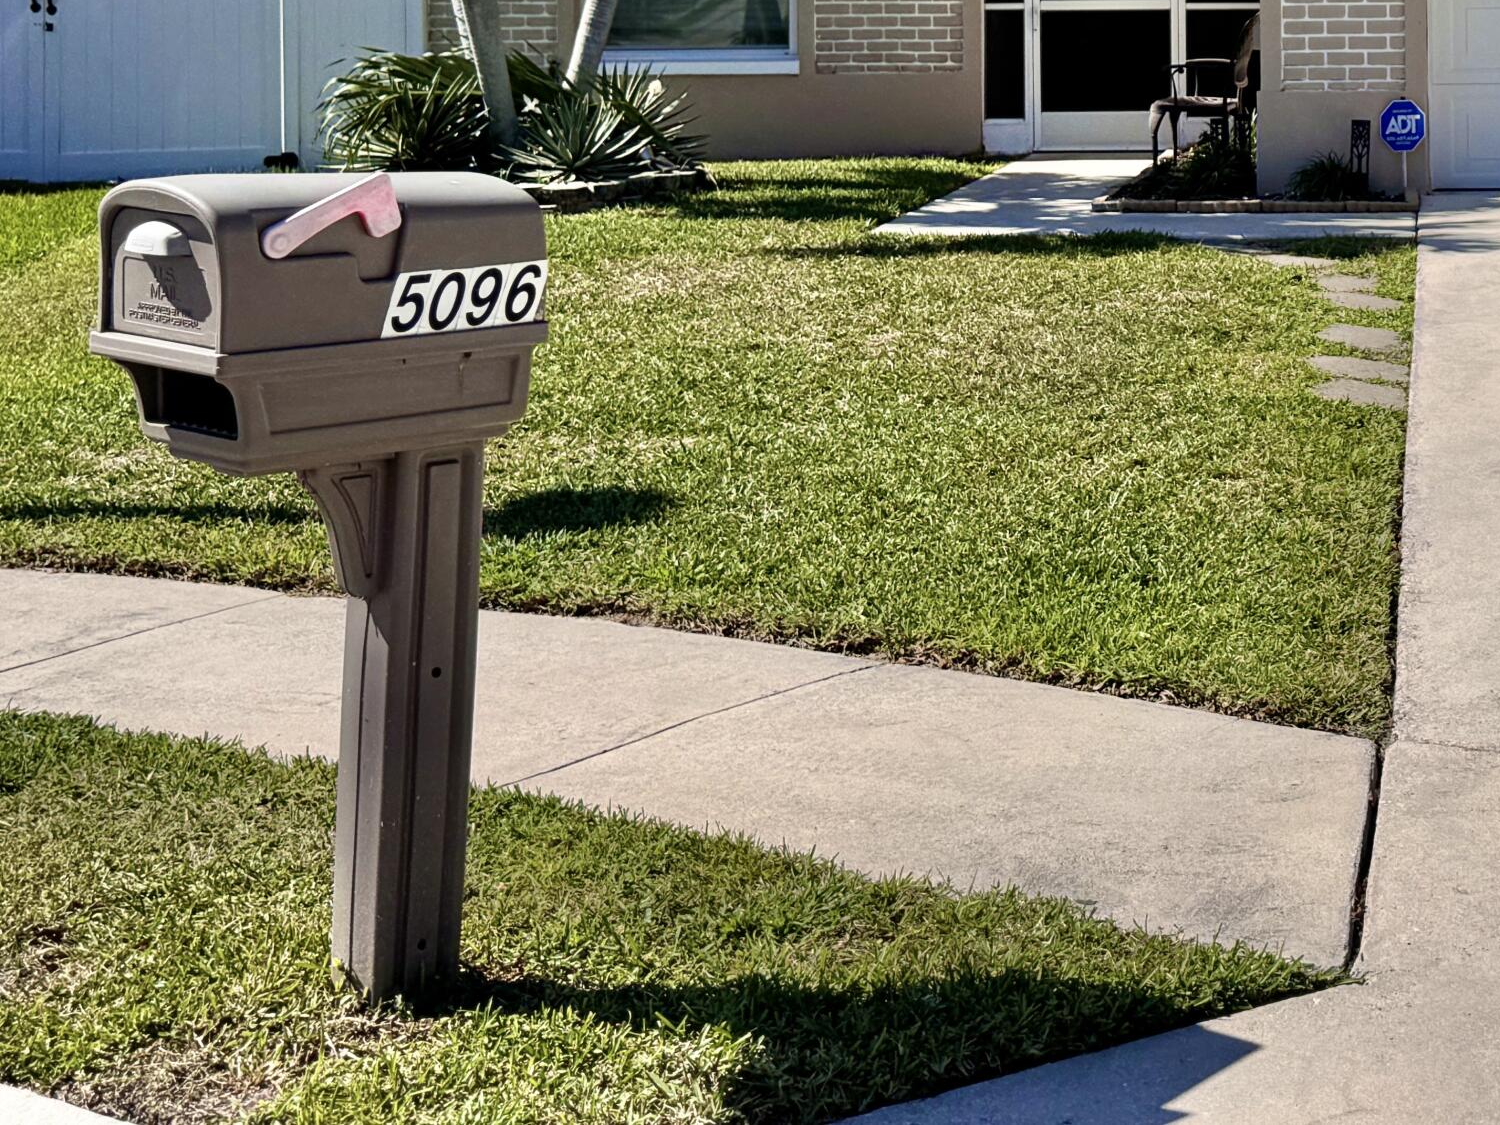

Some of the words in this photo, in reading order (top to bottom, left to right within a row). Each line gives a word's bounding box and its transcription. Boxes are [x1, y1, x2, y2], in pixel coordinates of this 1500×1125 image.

[1385, 115, 1420, 135] ADT
[149, 283, 181, 302] MAIL
[391, 264, 542, 333] 5096
